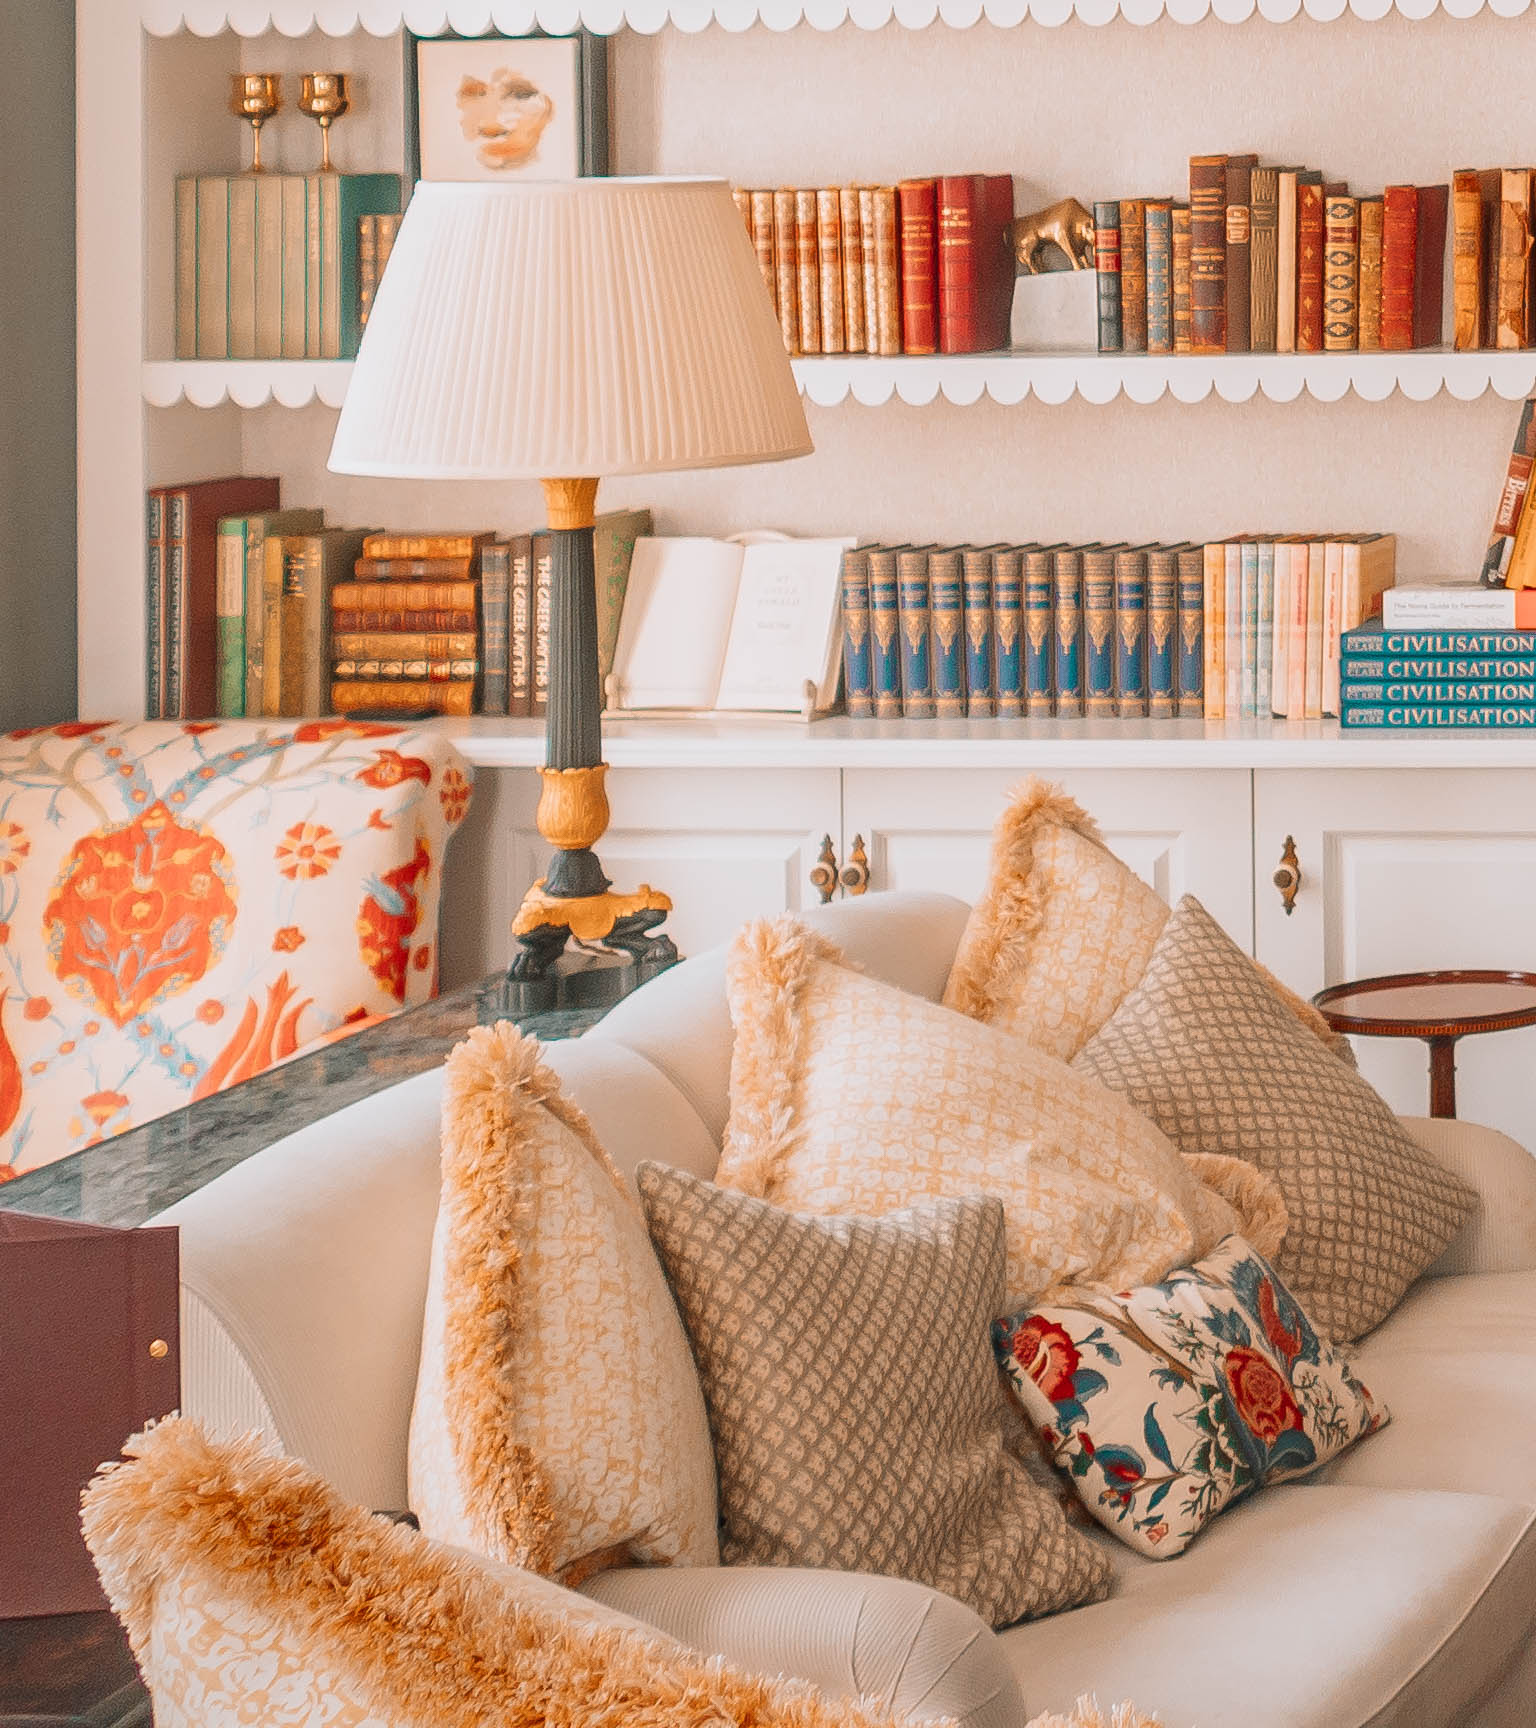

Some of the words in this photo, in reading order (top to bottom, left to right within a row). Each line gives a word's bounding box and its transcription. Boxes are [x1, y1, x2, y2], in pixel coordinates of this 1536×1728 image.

[513, 556, 526, 586] THE
[537, 556, 551, 586] THE
[513, 587, 526, 632] GREEK
[537, 587, 551, 633] GREEK
[1387, 636, 1535, 652] CIVILISATION
[513, 633, 526, 688] MYTHS
[537, 634, 551, 688] MYTHS
[1387, 661, 1535, 677] CIVILISATION
[1387, 685, 1535, 701] CIVILISATION
[1387, 709, 1535, 725] CIVILISATION
